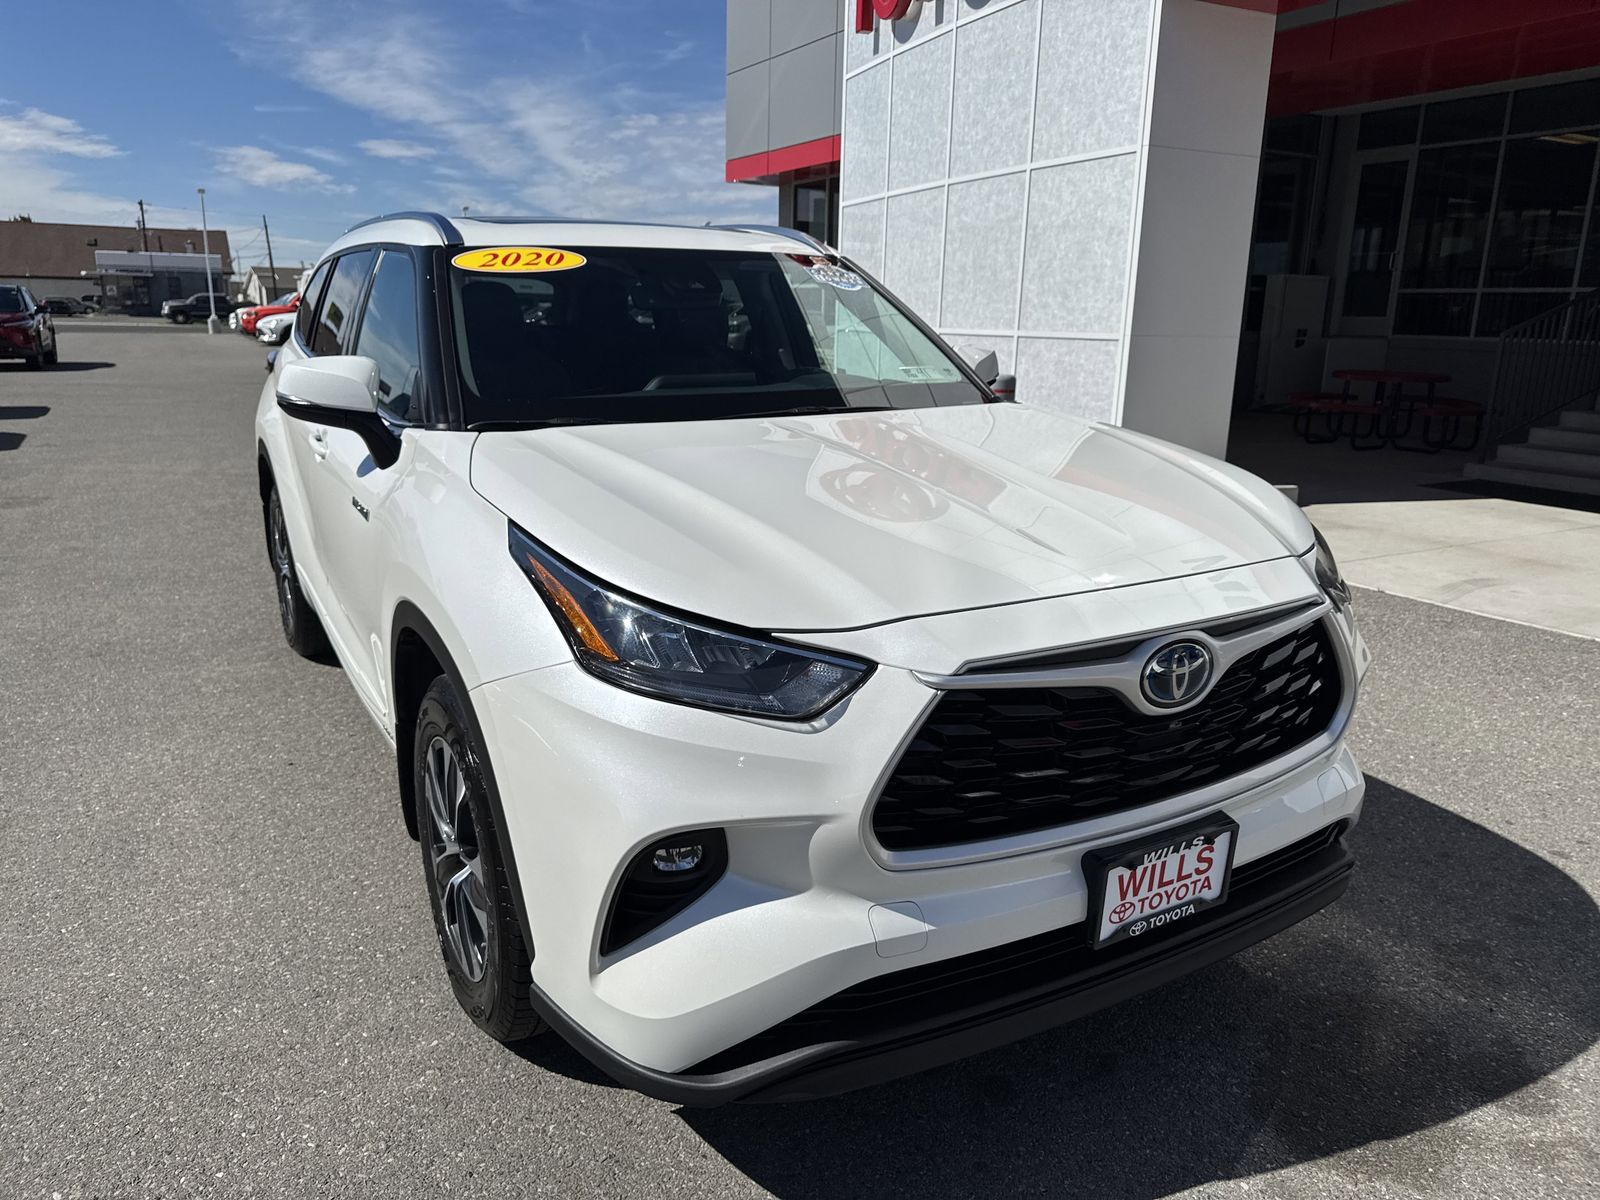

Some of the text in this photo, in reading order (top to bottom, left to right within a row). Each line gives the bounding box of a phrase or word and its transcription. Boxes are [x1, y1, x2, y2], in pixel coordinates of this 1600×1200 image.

[479, 252, 565, 268] 2020
[1143, 836, 1205, 864] WILLS
[1118, 845, 1215, 902] WILLS
[1138, 876, 1212, 914] TOYOTA
[1149, 904, 1195, 929] TOYOTA
